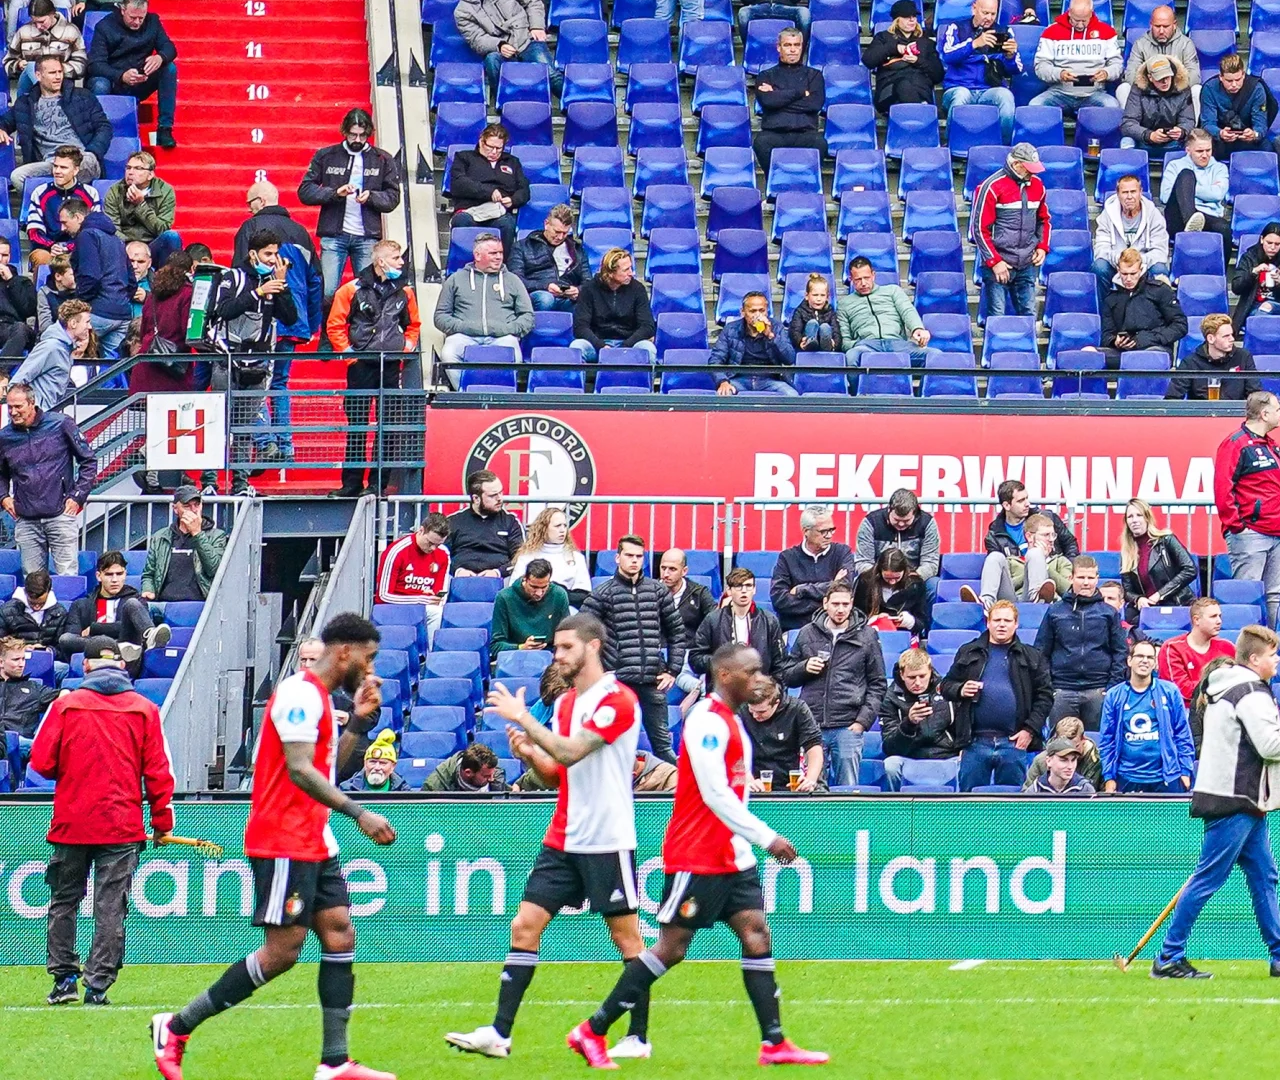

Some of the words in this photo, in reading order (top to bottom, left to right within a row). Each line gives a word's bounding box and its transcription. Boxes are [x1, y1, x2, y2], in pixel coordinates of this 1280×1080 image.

[244, 0, 266, 17] 12
[245, 41, 263, 59] 11
[1056, 43, 1102, 57] FEYENOORD
[246, 83, 270, 101] 10
[250, 128, 264, 144] 9
[254, 168, 268, 183] 8
[168, 409, 205, 454] H
[474, 418, 586, 462] FEYENOORD
[425, 833, 506, 916] in
[855, 829, 1067, 914] land
